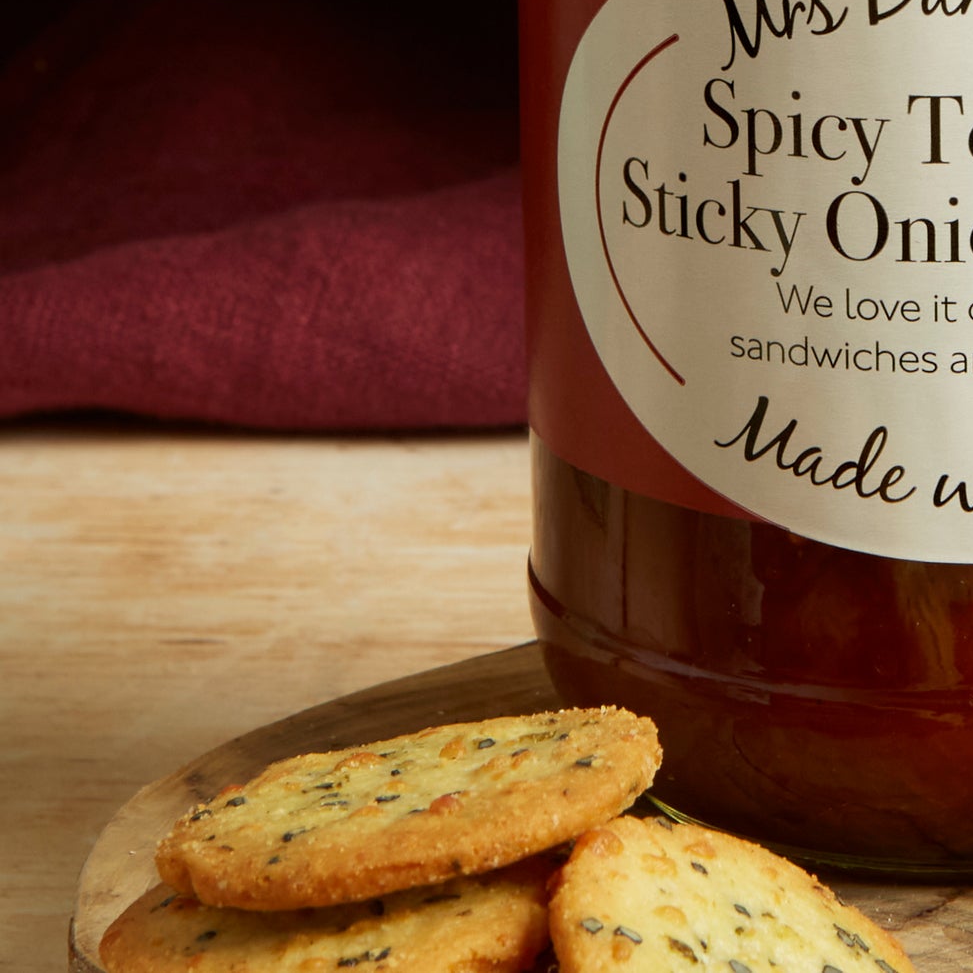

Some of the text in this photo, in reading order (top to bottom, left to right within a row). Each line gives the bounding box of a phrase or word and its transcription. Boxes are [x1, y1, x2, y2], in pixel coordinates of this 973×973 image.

[703, 77, 892, 187] Spicy
[622, 156, 808, 278] Sticky
[730, 335, 939, 374] sandwiches
[775, 281, 834, 318] We
[845, 288, 921, 322] love
[932, 294, 958, 323] it
[713, 395, 917, 504] Made
